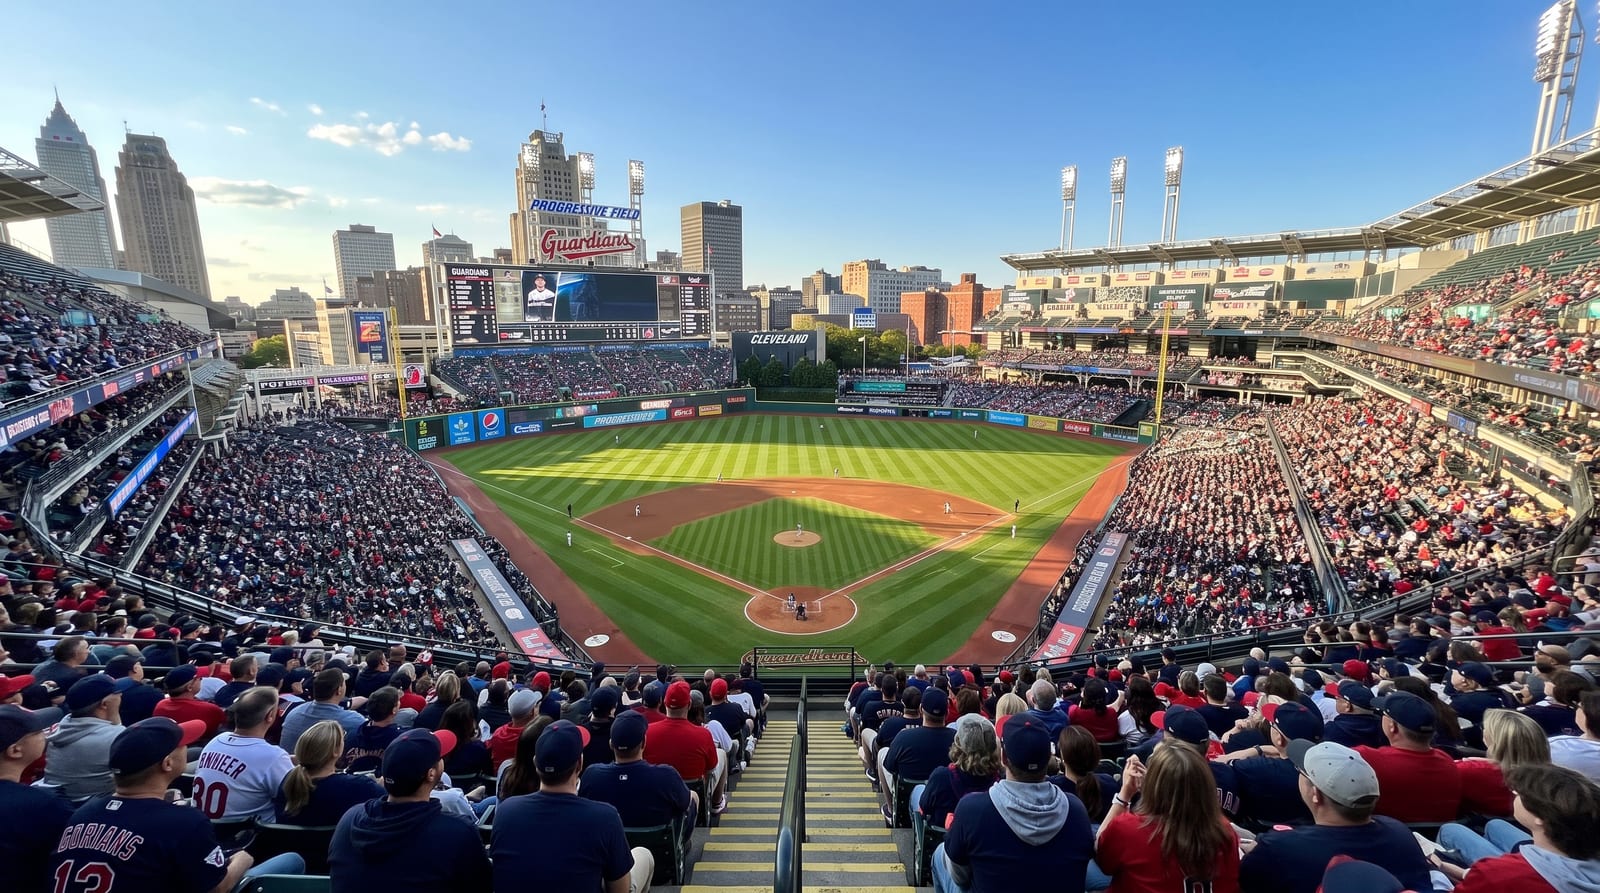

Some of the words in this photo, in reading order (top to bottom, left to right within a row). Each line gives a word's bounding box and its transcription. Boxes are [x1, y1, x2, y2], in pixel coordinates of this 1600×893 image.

[530, 199, 608, 217] PROGRESSIVE
[610, 206, 641, 220] FIELD
[541, 228, 636, 260] Guardians
[451, 267, 489, 276] GUARDIANS
[750, 333, 809, 344] CLEVELAND
